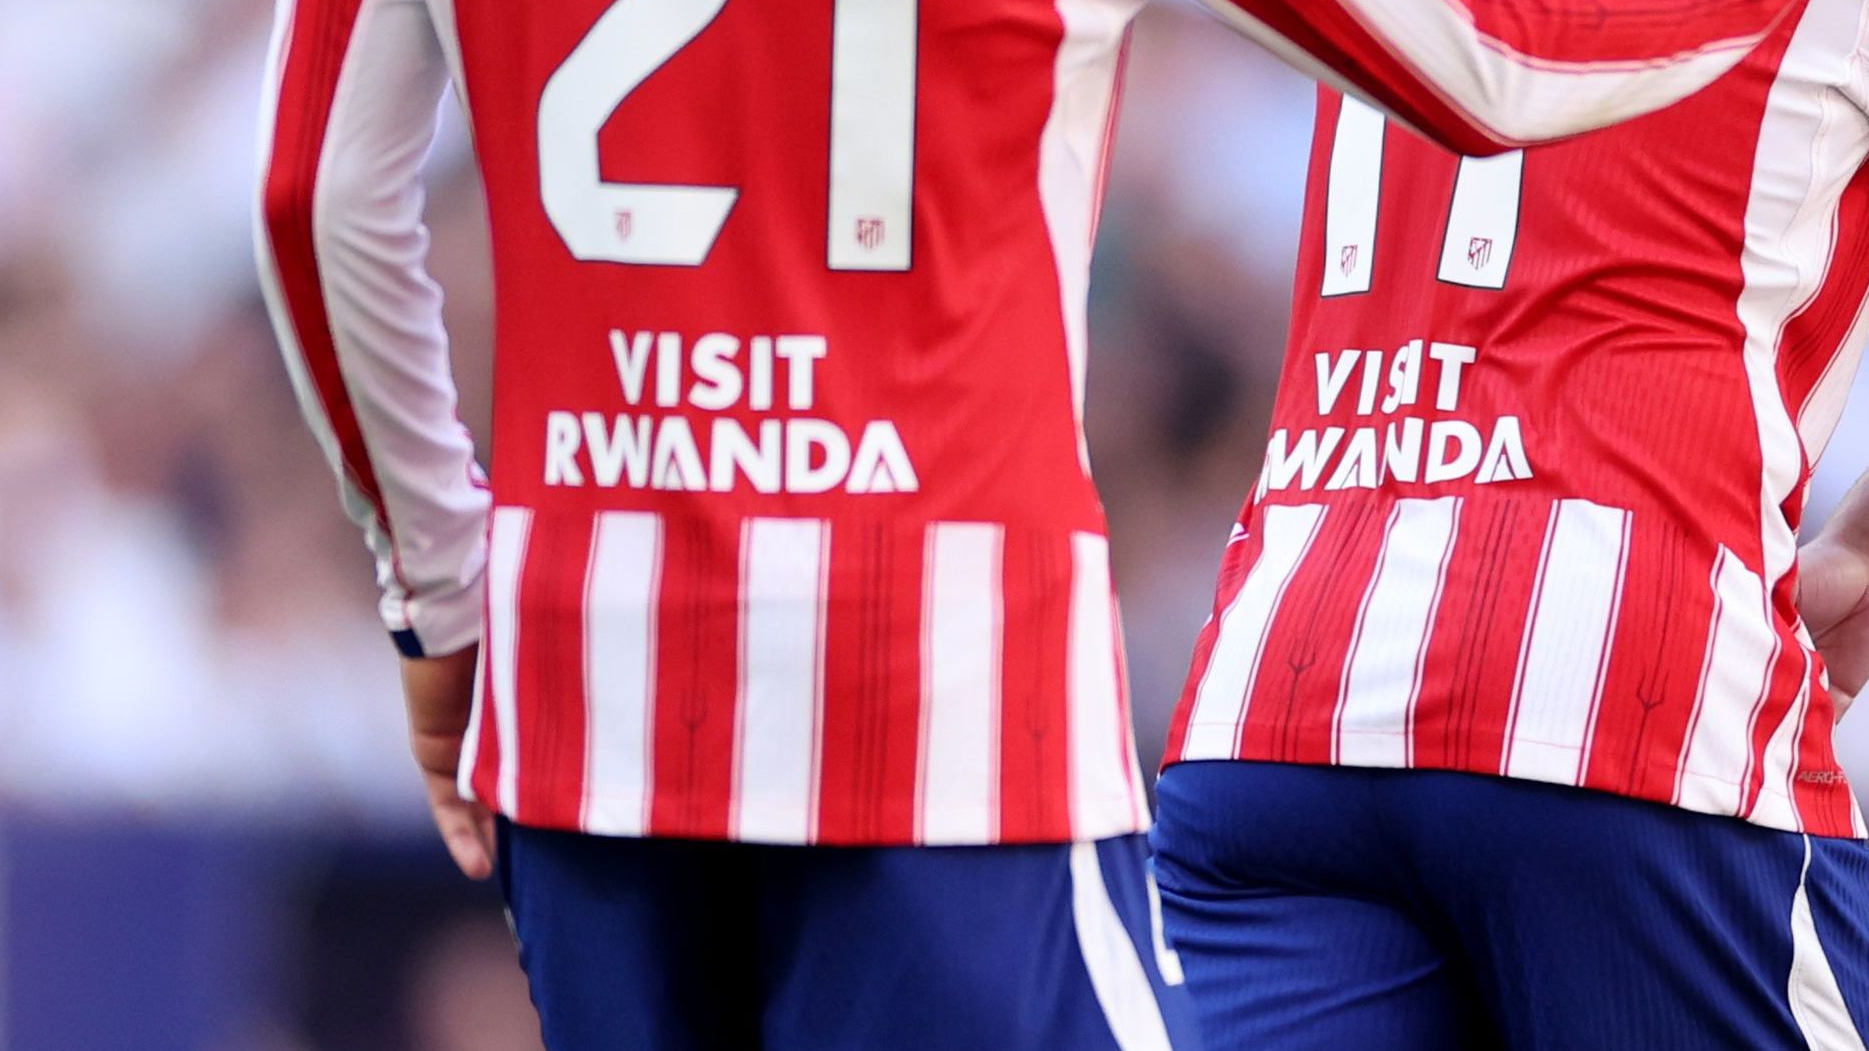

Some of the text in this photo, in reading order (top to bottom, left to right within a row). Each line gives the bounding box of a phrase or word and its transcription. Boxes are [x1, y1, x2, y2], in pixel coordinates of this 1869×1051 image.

[608, 329, 827, 410] VISIT
[1315, 339, 1477, 416] VISIT
[544, 410, 919, 493] RWANDA
